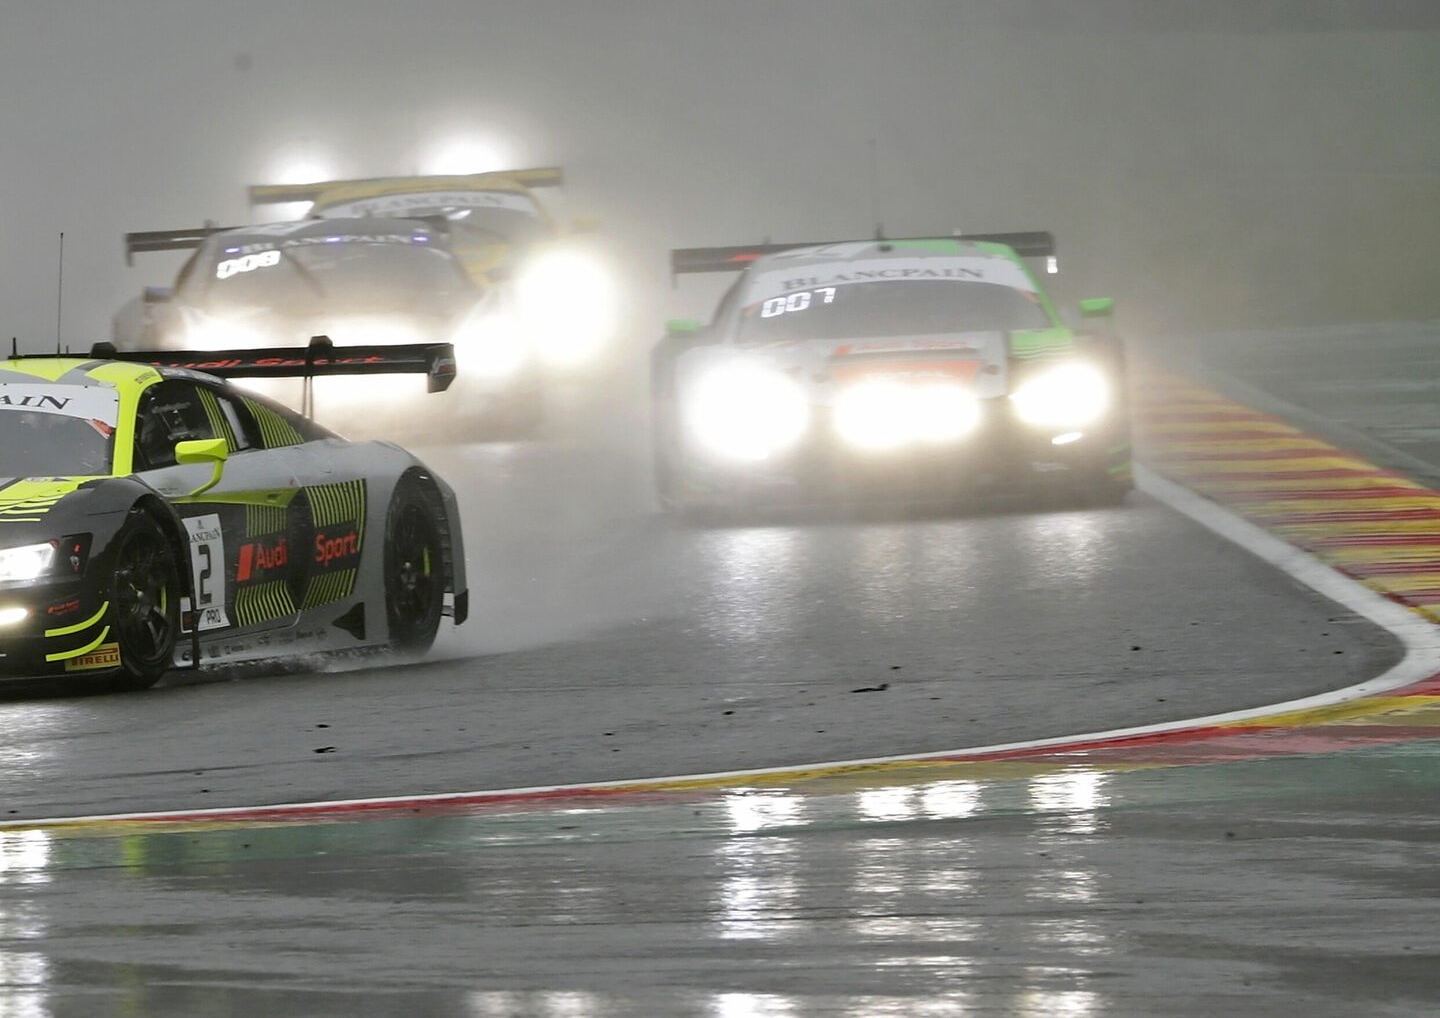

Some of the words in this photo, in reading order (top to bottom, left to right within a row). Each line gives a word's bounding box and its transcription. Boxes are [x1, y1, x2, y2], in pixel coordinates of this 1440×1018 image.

[783, 268, 984, 289] BLANCPAIN
[761, 287, 836, 318] 007
[256, 538, 288, 570] Audi
[316, 531, 358, 567] Sport
[198, 544, 212, 605] 2
[206, 607, 221, 624] PRO
[71, 654, 119, 667] PIRELLI
